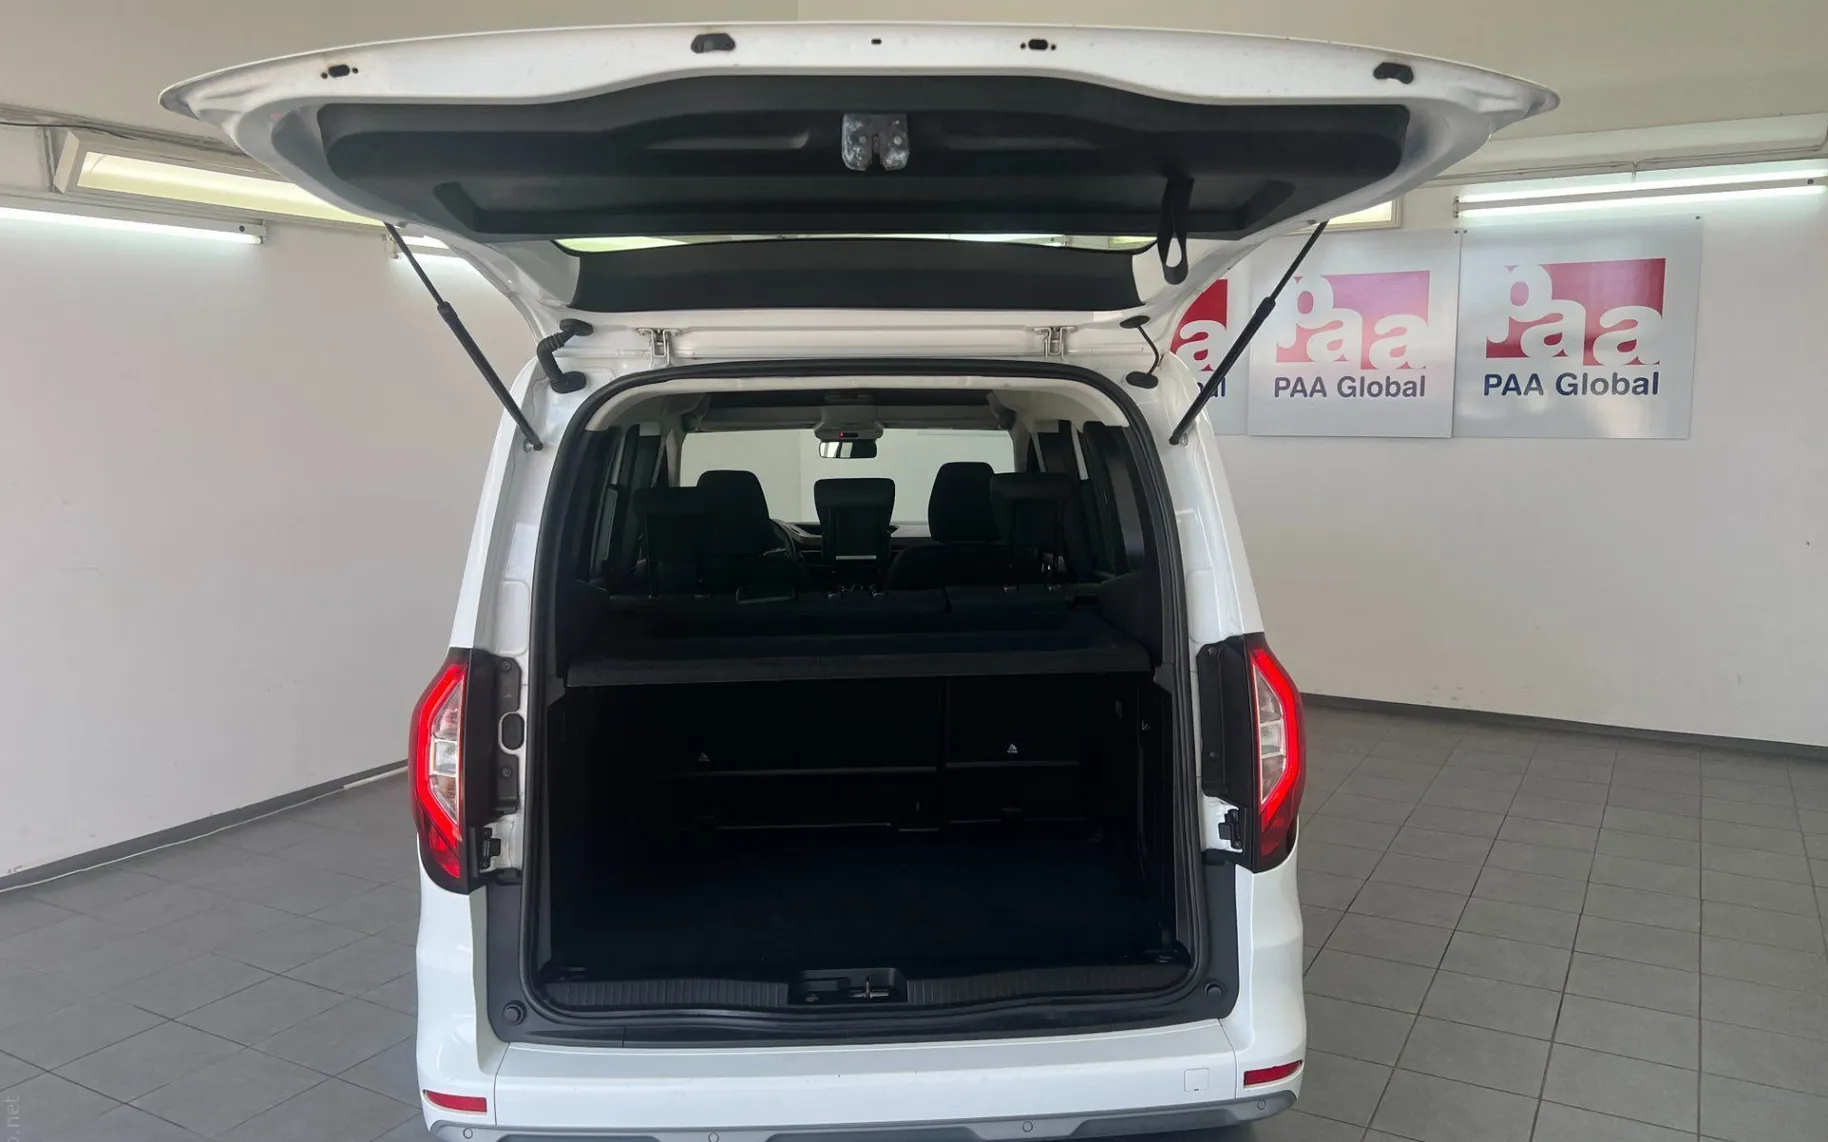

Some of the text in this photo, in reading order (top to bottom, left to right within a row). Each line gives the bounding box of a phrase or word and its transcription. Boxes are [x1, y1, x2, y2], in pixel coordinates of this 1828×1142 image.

[1275, 271, 1429, 369] paa
[1485, 260, 1664, 366] paa
[1274, 375, 1426, 398] PAA Global
[1483, 371, 1659, 396] PAA Global
